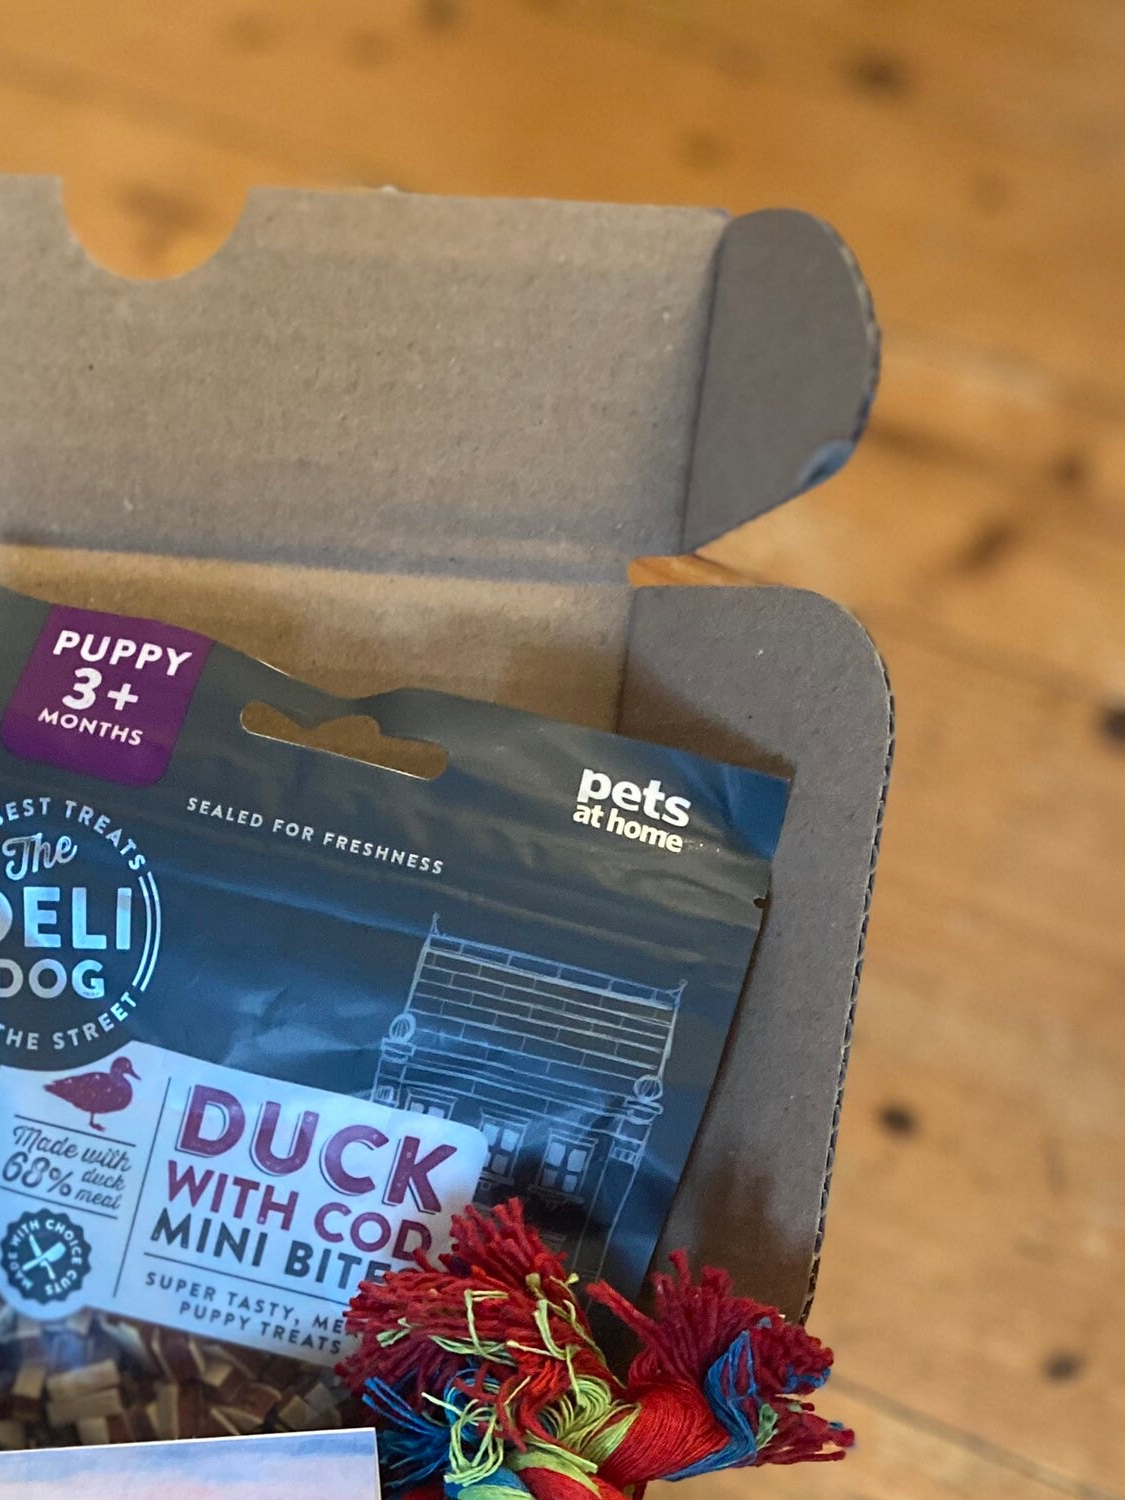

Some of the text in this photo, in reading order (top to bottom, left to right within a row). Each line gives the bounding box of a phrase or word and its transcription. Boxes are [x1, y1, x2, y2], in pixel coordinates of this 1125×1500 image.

[53, 629, 192, 676] PUPPY
[62, 667, 139, 711] 3+
[37, 708, 144, 745] MONTHS
[577, 768, 691, 827] pets
[65, 800, 146, 871] TREATS
[187, 797, 444, 875] SEALED FOR FRESHNESS
[573, 804, 683, 853] at home
[1, 832, 78, 881] The
[52, 991, 137, 1050] STREET
[2, 1151, 74, 1196] 68%
[13, 1125, 132, 1172] Made with
[176, 1084, 457, 1214] DUCK
[75, 1188, 123, 1210] meat
[81, 1168, 125, 1191] duck
[167, 1160, 432, 1262] WITH COD
[8, 1219, 83, 1296] MADE WITH CHOICE CUTS
[150, 1207, 419, 1290] MINI BITE
[146, 1272, 216, 1301] SUPER
[228, 1292, 300, 1327] TASTY,
[179, 1301, 342, 1355] PUPPY TREATS
